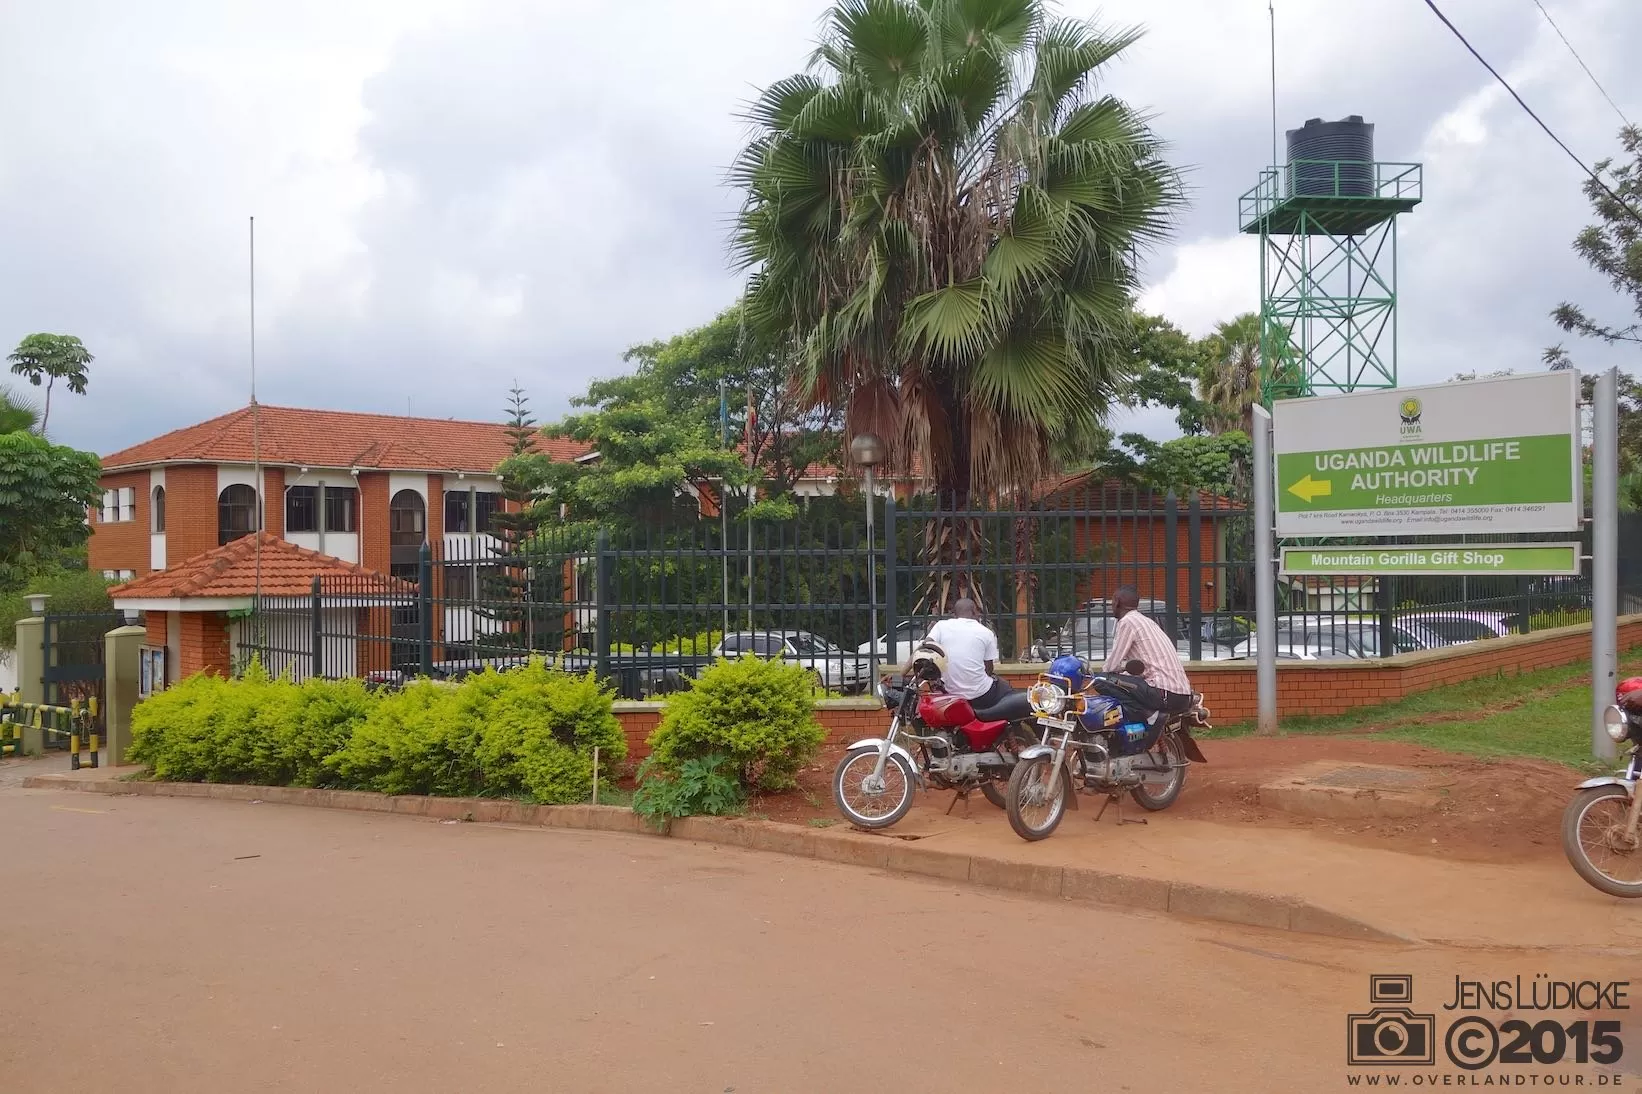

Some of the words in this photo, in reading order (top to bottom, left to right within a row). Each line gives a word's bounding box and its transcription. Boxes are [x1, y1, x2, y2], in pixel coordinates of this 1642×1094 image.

[1400, 426, 1421, 434] UWA
[1315, 450, 1405, 471] UGANDA
[1410, 442, 1520, 465] WILDLIFE
[1350, 467, 1478, 491] AUTHORITY
[1375, 493, 1453, 506] Headquarters
[1505, 505, 1521, 513] 0414
[1522, 504, 1546, 512] 346291
[1311, 554, 1374, 566] Mountain
[1378, 552, 1426, 565] Gorilla
[1431, 551, 1458, 565] Gift
[1463, 551, 1504, 567] Shop
